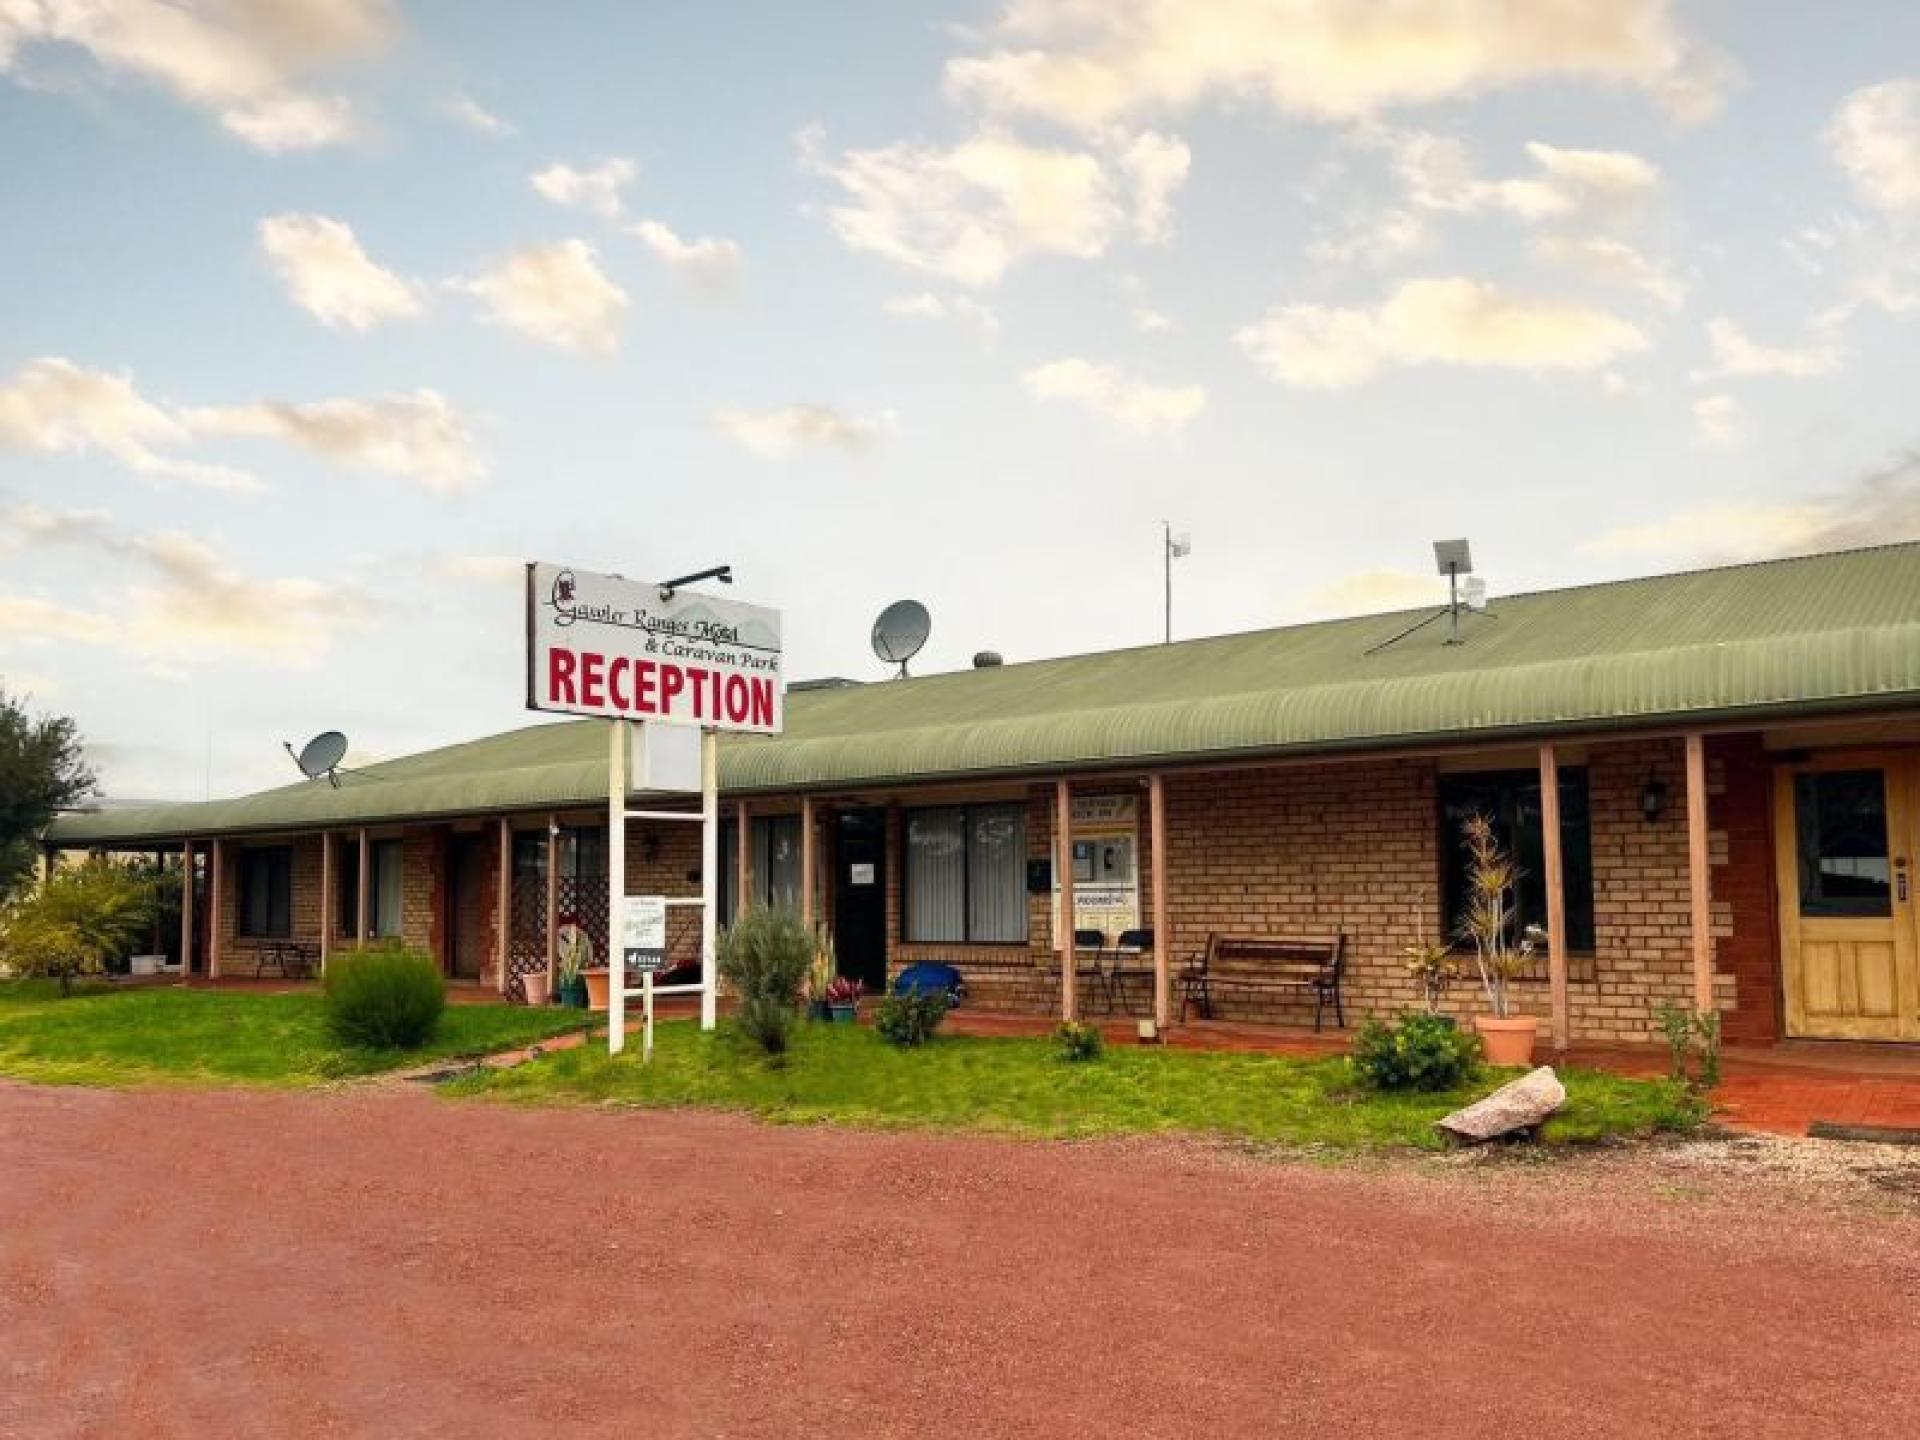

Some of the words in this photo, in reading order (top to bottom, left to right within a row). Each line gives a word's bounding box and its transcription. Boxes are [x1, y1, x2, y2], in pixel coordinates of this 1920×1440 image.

[634, 608, 690, 637] Ranges
[644, 638, 656, 654] &
[661, 640, 736, 665] Caravan
[739, 654, 779, 671] Park
[549, 647, 773, 727] RECEPTION
